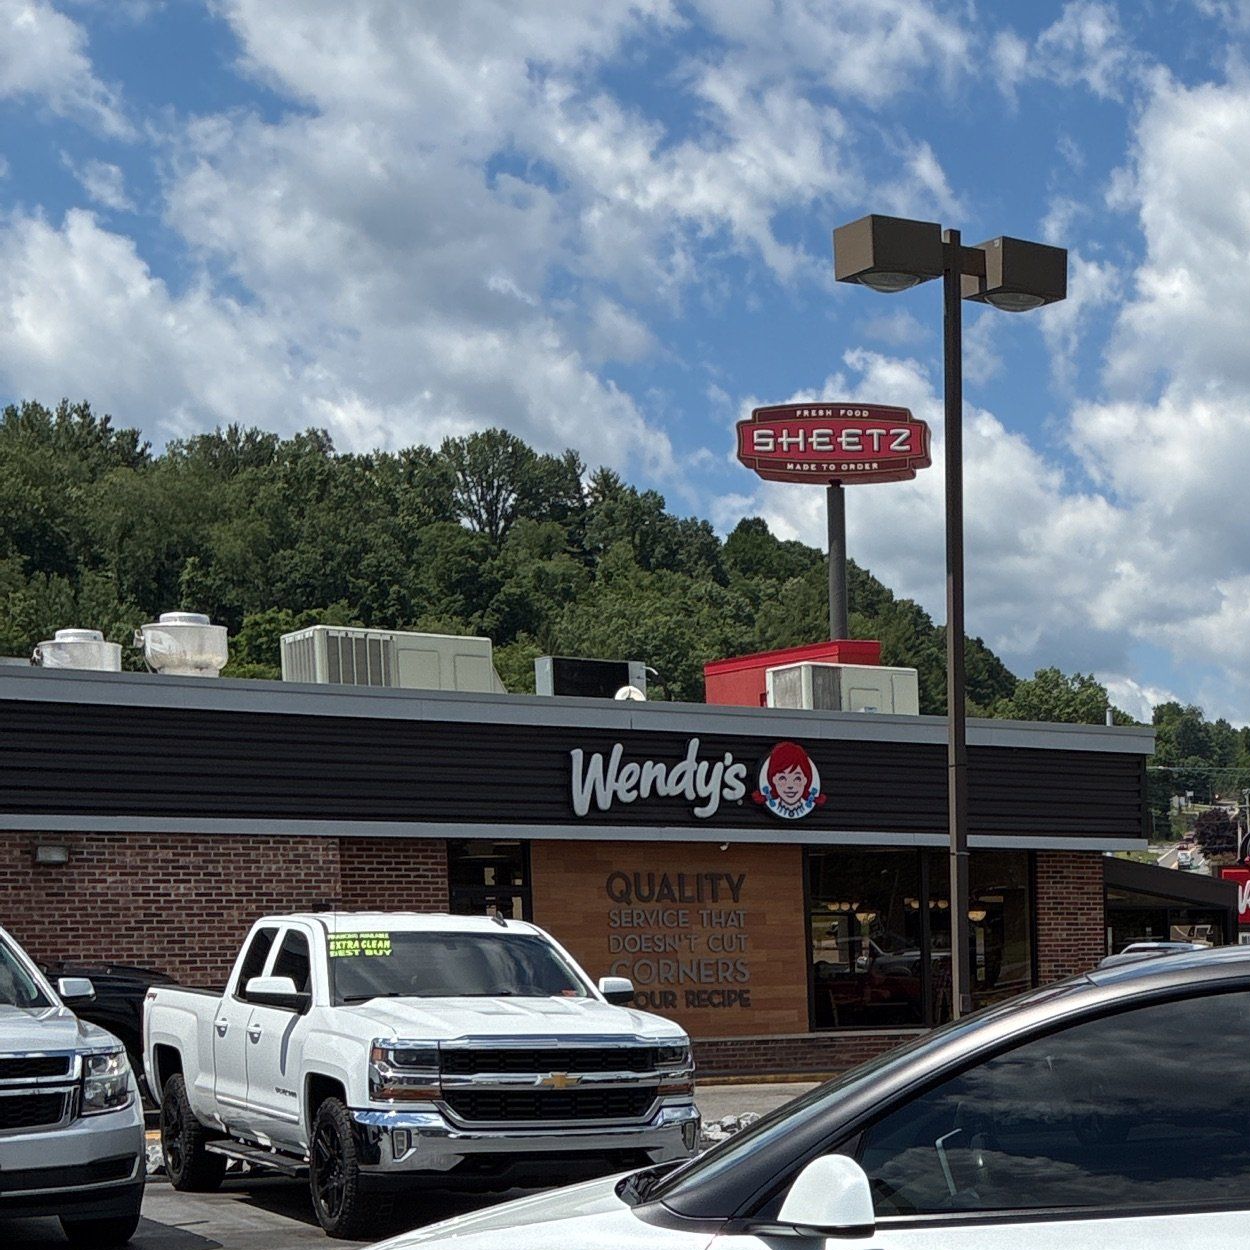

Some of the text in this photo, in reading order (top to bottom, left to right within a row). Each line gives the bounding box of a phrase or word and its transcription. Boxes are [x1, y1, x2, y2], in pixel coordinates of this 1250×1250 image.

[796, 409, 869, 417] FRESH FOOD
[753, 428, 912, 452] SHEETZ
[786, 463, 878, 471] MADE TO ORDER
[570, 738, 747, 818] Wendy's
[606, 871, 747, 905] QUALITY
[609, 909, 749, 929] SERVICE THAT
[330, 940, 391, 950] EXTRA CLEAN
[330, 949, 392, 957] BEST BUY
[609, 934, 749, 954] DOESN'T CUT
[610, 957, 751, 985] CORNERS
[634, 988, 751, 1010] OUR RECIPE
